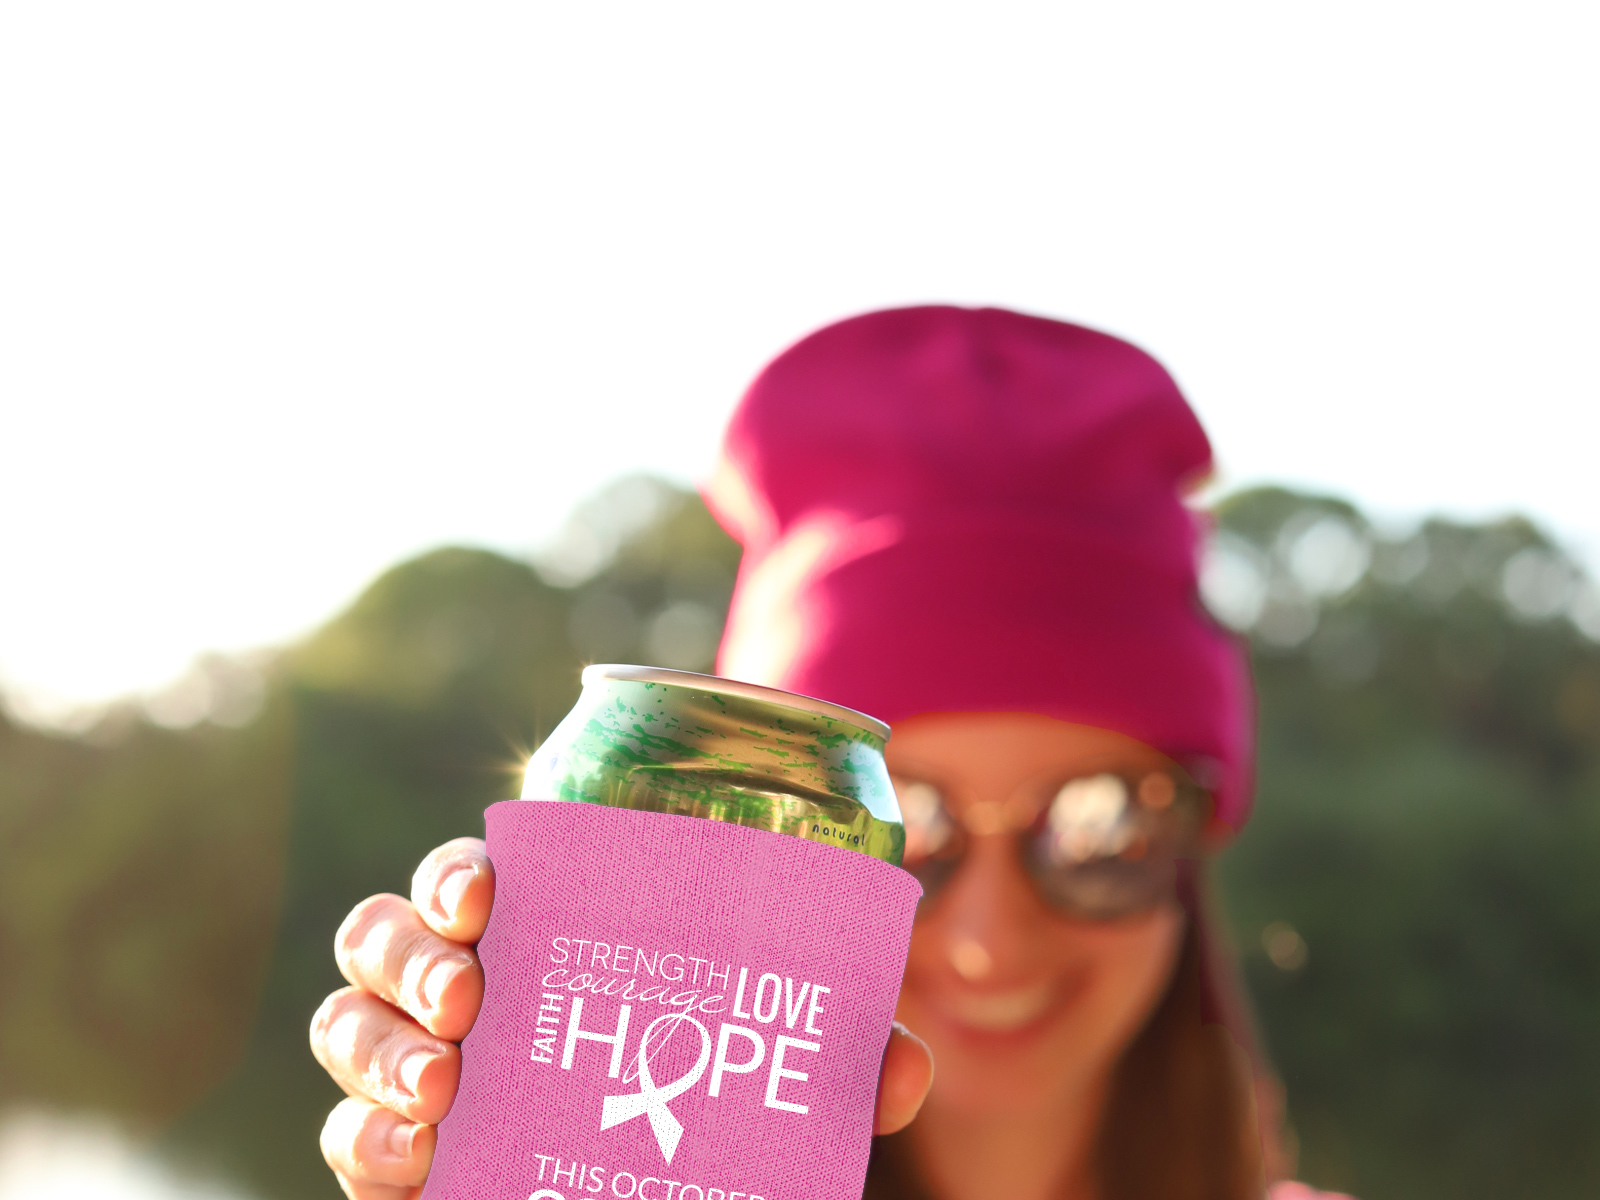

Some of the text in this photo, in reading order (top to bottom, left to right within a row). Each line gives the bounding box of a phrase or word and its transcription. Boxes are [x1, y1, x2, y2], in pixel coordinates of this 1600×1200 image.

[812, 824, 866, 847] natural
[550, 937, 731, 990] STRENGTH
[530, 993, 564, 1064] FAITH
[732, 967, 831, 1036] LOVE
[561, 996, 821, 1116] HOPE
[535, 1154, 605, 1193] THIS
